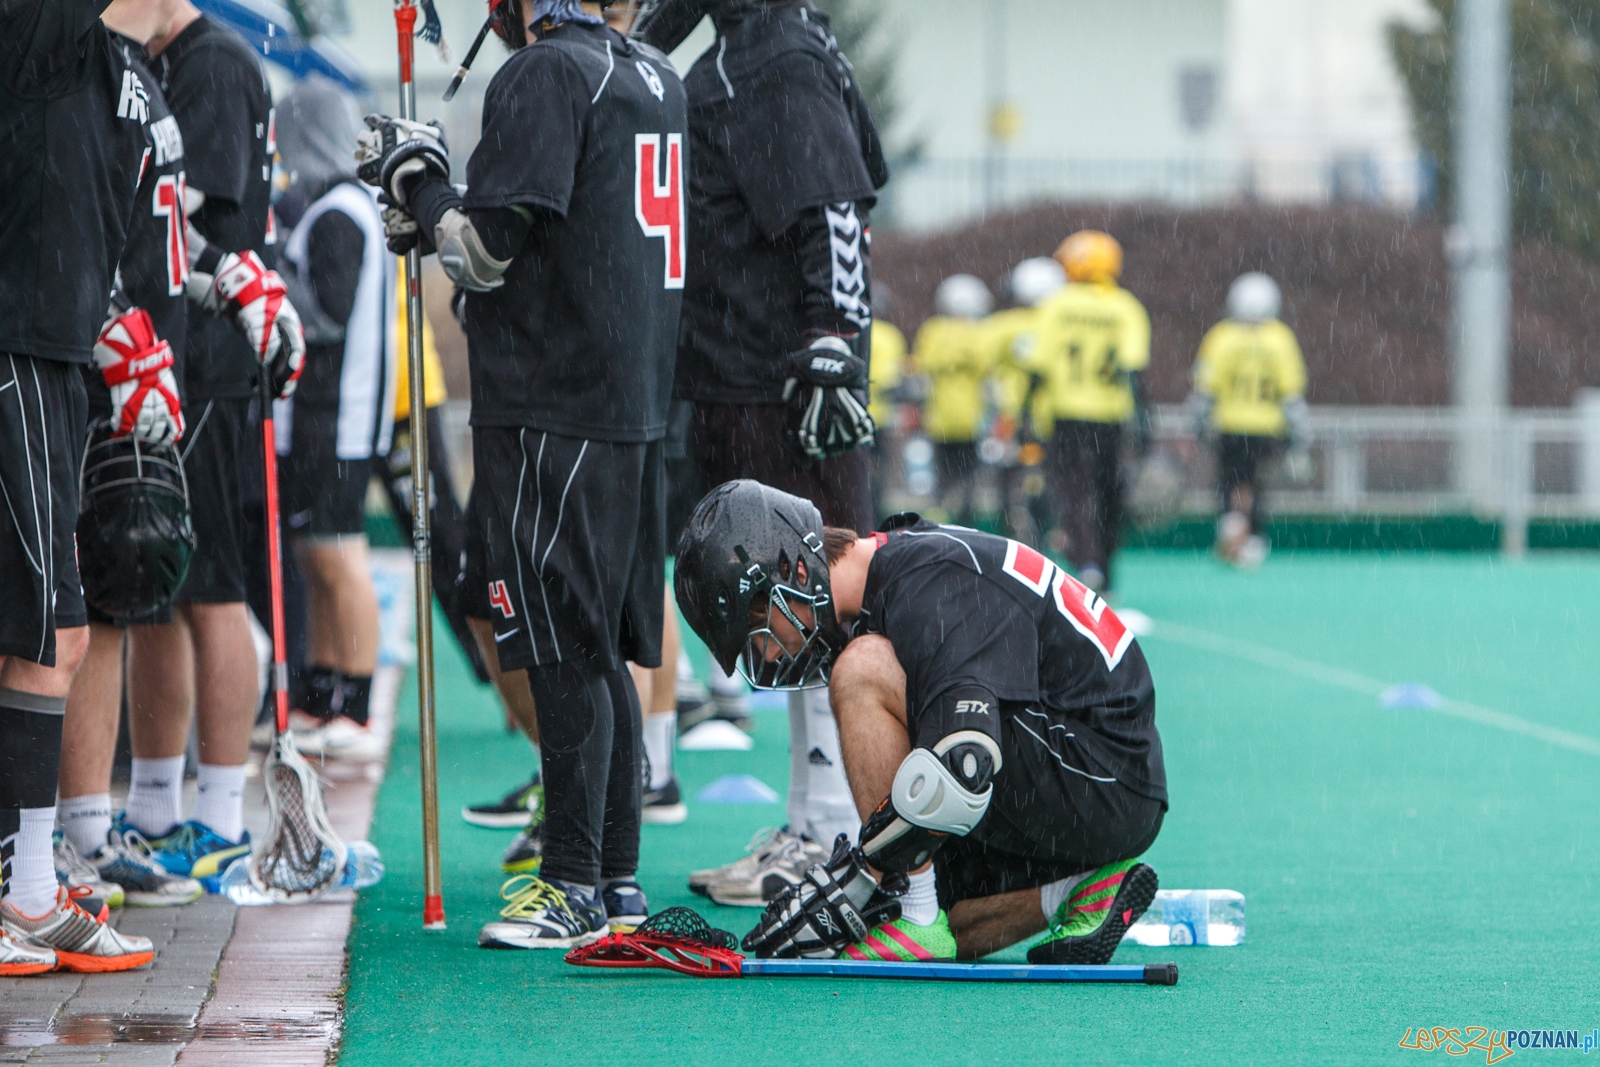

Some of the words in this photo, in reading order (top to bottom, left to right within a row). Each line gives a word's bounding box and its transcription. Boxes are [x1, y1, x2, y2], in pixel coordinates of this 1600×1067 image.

[634, 133, 686, 289] 4
[810, 356, 846, 374] STX
[488, 579, 516, 619] 4
[954, 700, 989, 715] STX
